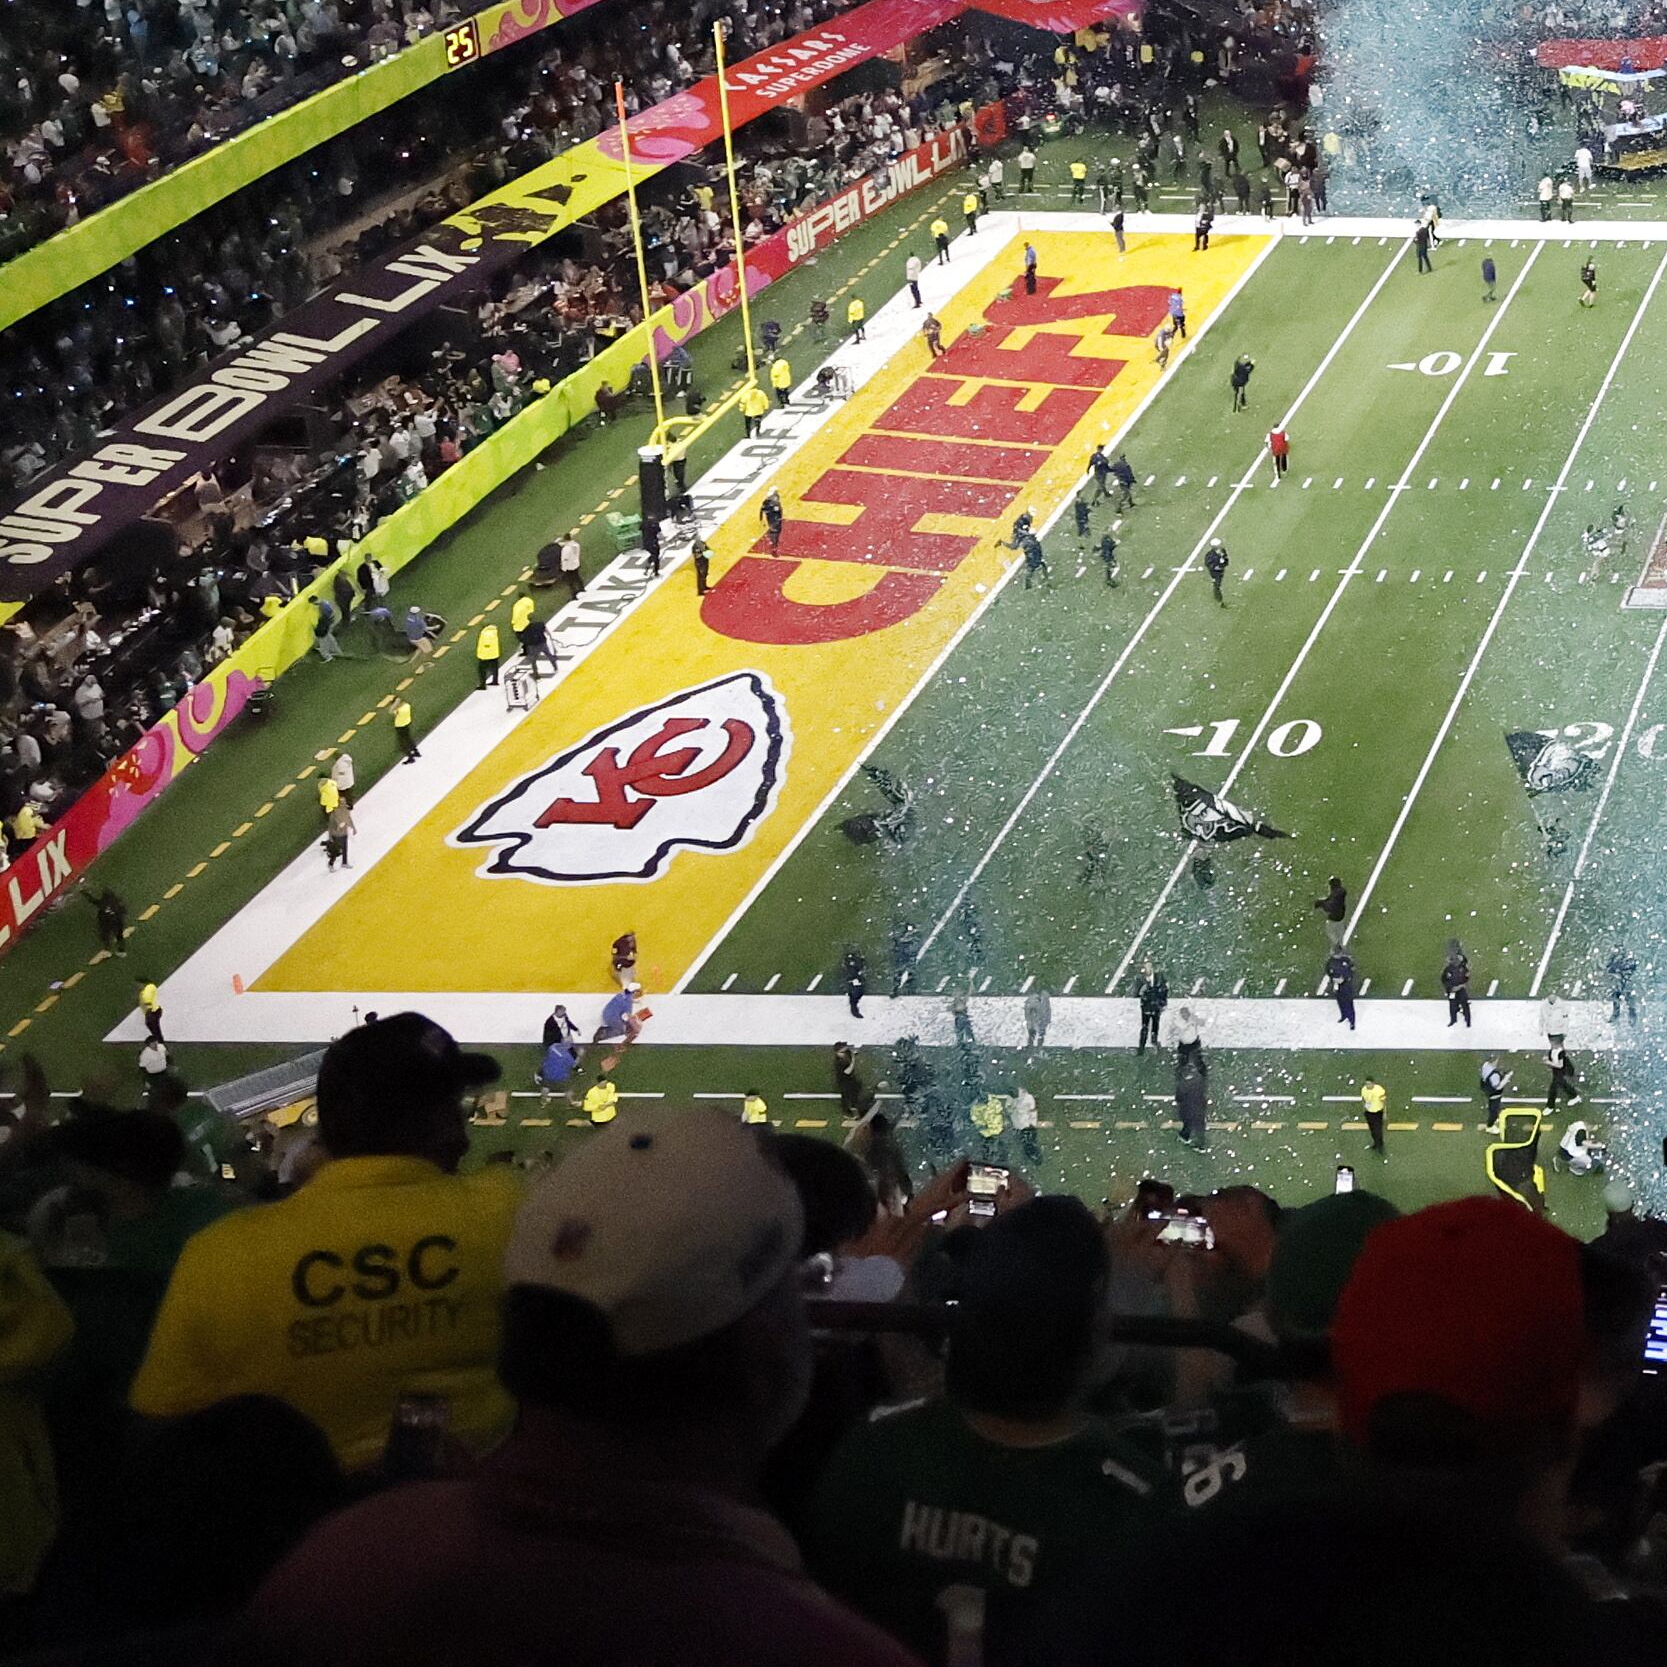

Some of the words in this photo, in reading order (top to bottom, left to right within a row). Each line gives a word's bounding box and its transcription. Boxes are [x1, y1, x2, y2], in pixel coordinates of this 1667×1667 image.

[446, 26, 474, 65] 25
[755, 42, 872, 99] SUPERDOME
[786, 191, 861, 263] SUPER
[1418, 351, 1520, 377] 10
[0, 442, 188, 565] SUPER
[132, 317, 382, 443] BOWL
[334, 244, 482, 313] LIX
[699, 274, 1183, 646] CHIEFS
[552, 530, 690, 633] TAKE
[532, 717, 756, 830] KC
[1190, 718, 1323, 758] 10
[8, 828, 73, 927] LIX
[290, 1235, 461, 1308] CSC
[285, 1295, 468, 1360] SECURITY
[899, 1499, 1041, 1589] HURTS
